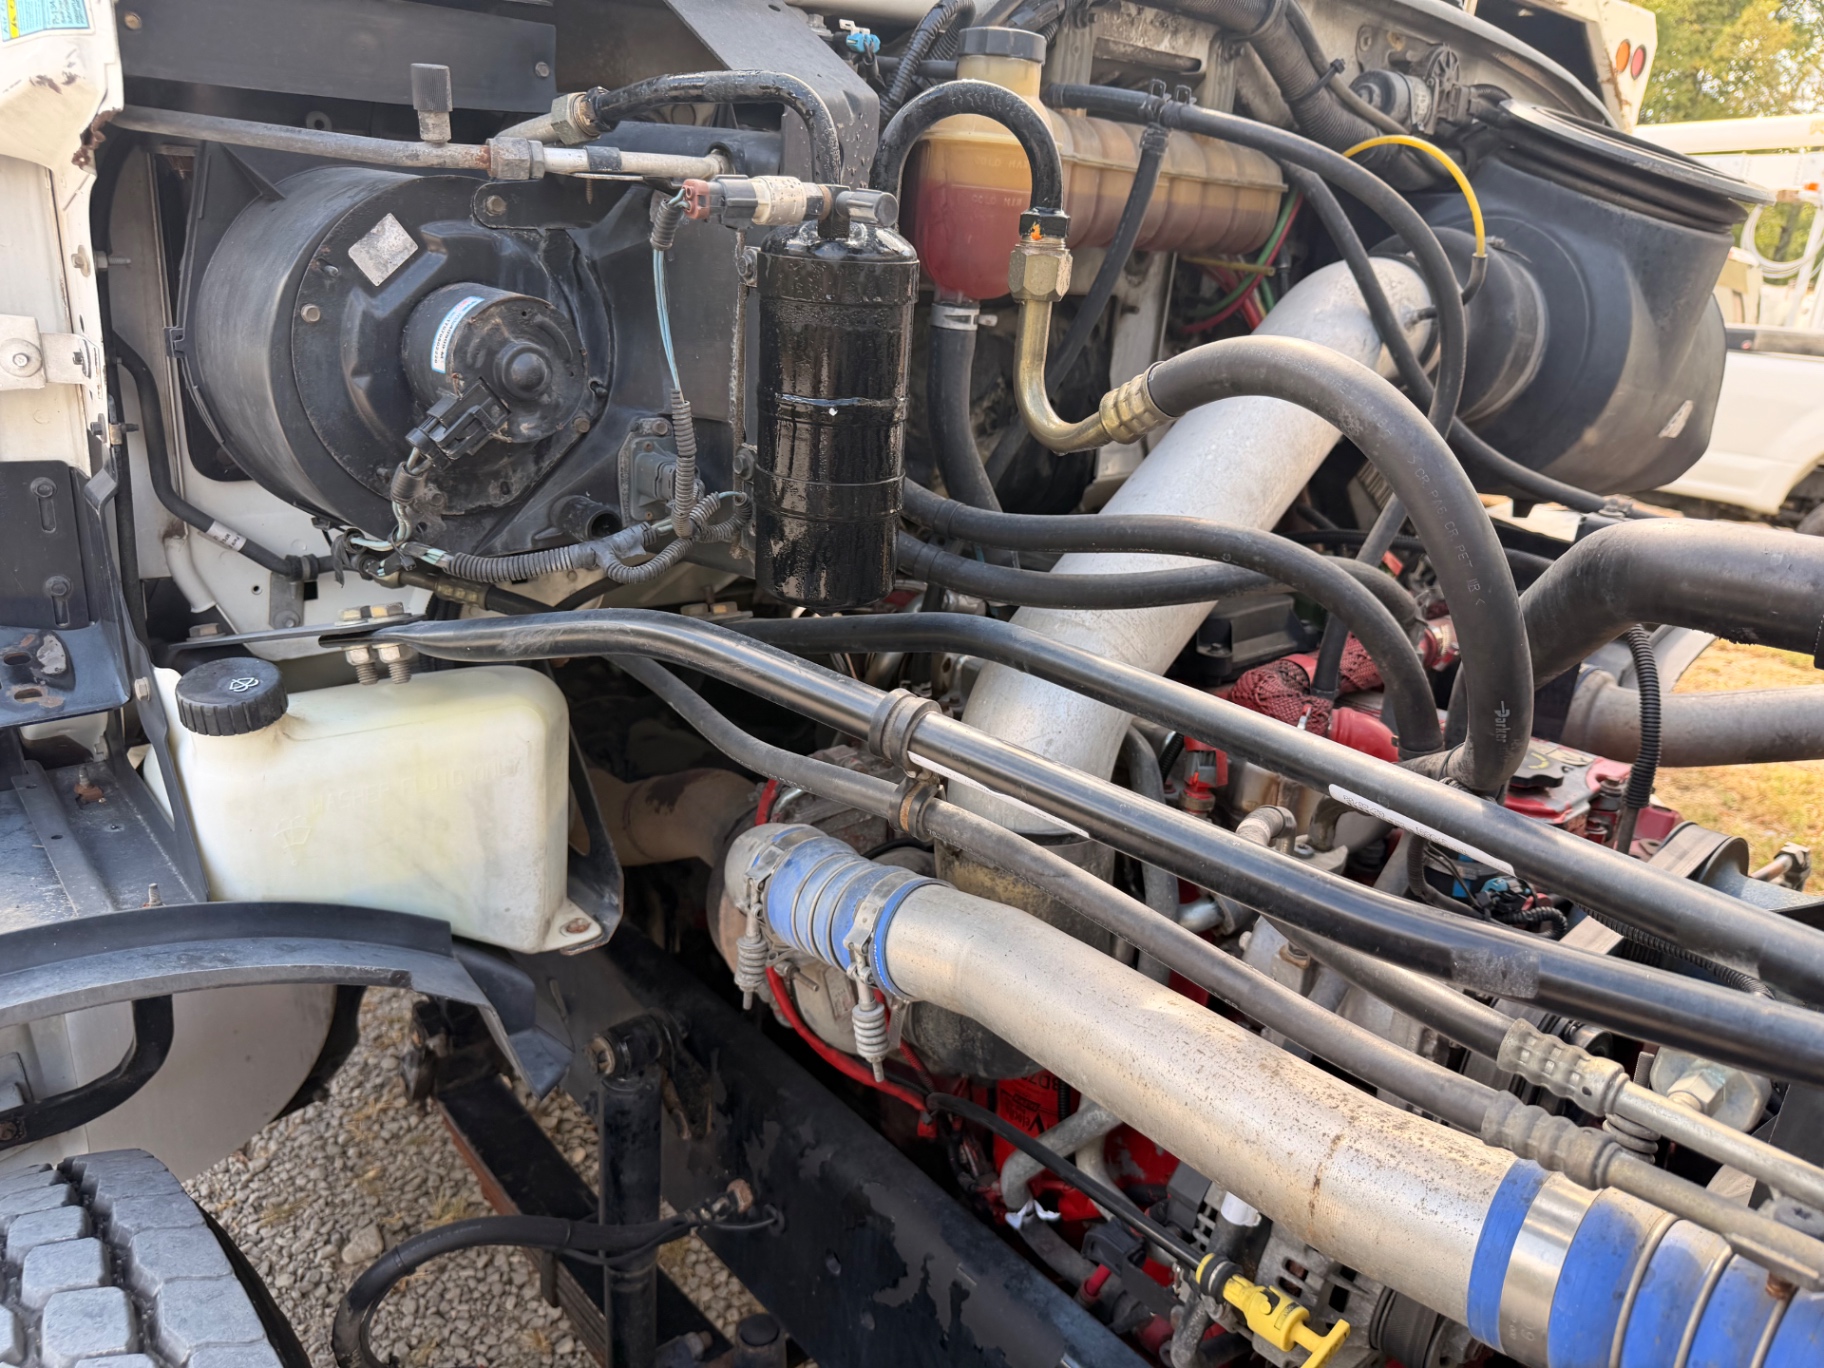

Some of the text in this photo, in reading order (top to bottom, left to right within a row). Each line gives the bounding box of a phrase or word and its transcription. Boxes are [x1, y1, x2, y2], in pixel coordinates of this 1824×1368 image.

[1494, 701, 1511, 743] Parker
[311, 781, 390, 814] WASHER
[401, 768, 464, 799] FLUID
